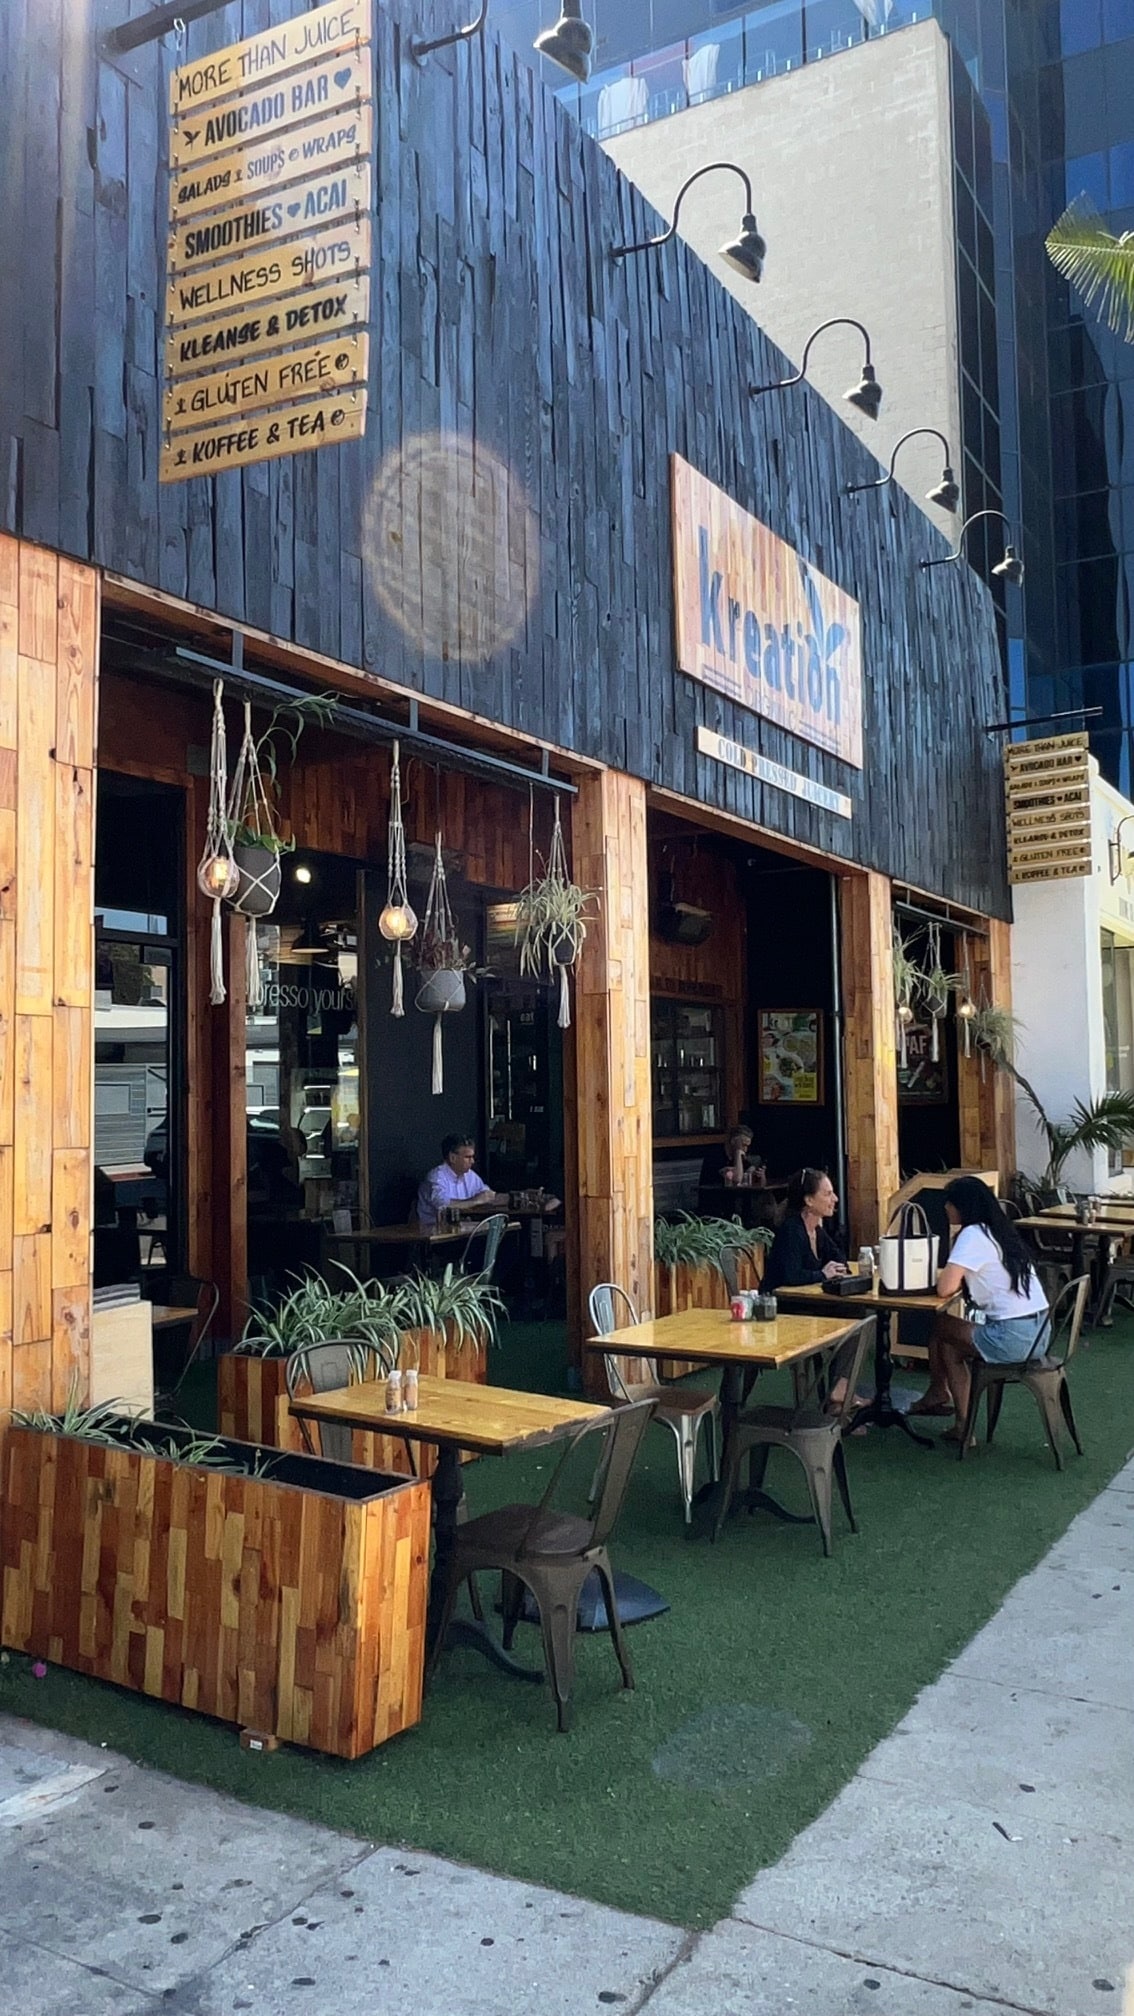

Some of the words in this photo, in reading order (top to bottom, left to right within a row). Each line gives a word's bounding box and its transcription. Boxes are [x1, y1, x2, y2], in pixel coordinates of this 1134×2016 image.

[179, 58, 232, 101] MORE
[238, 34, 287, 78] THAN
[295, 8, 356, 54] JUICE
[204, 91, 285, 147] AVOCADO
[291, 74, 330, 112] BAR
[178, 169, 232, 204] SALADS
[247, 149, 286, 180] SOUPS
[302, 124, 357, 160] WRAPS
[185, 203, 283, 260] SMOOTHIES
[304, 178, 348, 219] ACAI
[179, 263, 281, 310] WELLNESS
[292, 241, 351, 276] SHOTS
[180, 320, 261, 362] KLEANSE
[266, 315, 280, 337] &
[285, 294, 348, 332] DETOX
[192, 431, 259, 464] KOFFEE
[266, 422, 280, 444] &
[287, 411, 325, 439] TEA
[718, 738, 746, 769] COLD
[751, 754, 797, 792] PRESSED
